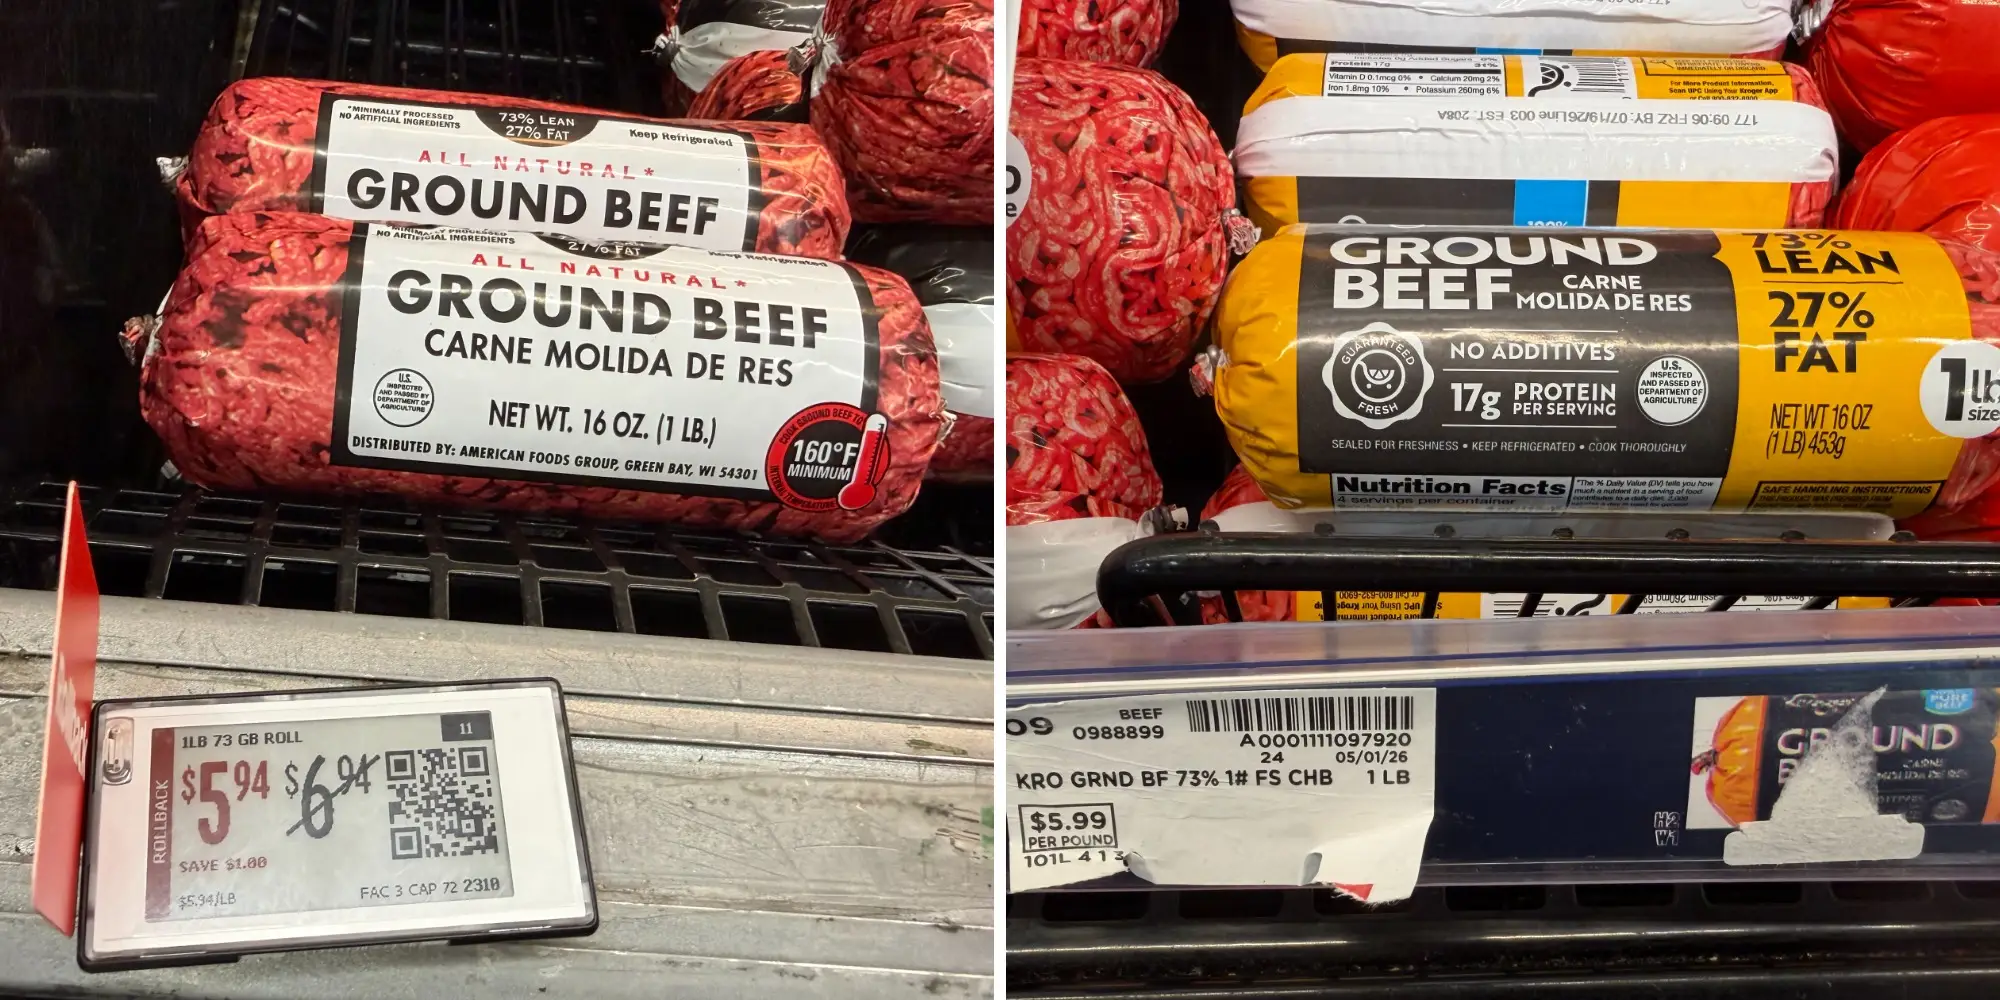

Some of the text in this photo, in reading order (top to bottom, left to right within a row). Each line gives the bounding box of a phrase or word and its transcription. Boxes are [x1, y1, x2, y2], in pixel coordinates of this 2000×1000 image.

[1329, 73, 1358, 81] Vitamin
[1367, 74, 1396, 83] 0.1mcg
[1398, 74, 1411, 82] 0%
[1463, 76, 1485, 84] 20mg
[1328, 84, 1344, 92] Iron
[1345, 85, 1369, 94] 1.8mg
[1372, 85, 1390, 93] 10%
[1416, 86, 1456, 94] Potassium
[1458, 86, 1485, 95] 260mg
[339, 112, 461, 129] NO ARTIFICIAL INGREDIENTS
[403, 110, 454, 121] PROCESSED
[499, 112, 575, 127] 73% LEAN
[1437, 110, 1470, 120] 208A
[1474, 110, 1504, 120] EST.
[1510, 110, 1536, 121] 003
[1629, 112, 1654, 124] BY:
[1658, 113, 1688, 124] FRZ
[1692, 113, 1729, 125] 09:06
[1734, 114, 1758, 126] 177
[505, 125, 570, 141] 27% FAT
[629, 128, 733, 147] Keep Refrigerated
[418, 150, 472, 167] ALL
[347, 168, 719, 236] GROUND BEEF
[1742, 233, 1852, 249] 73%
[1330, 236, 1657, 266] GROUND
[472, 253, 535, 271] ALL
[1755, 250, 1900, 275] LEAN
[1333, 268, 1513, 310] BEEF
[1563, 274, 1642, 290] CARNE
[387, 269, 828, 349] GROUND BEEF
[1516, 292, 1692, 312] MOLIDA DE RES
[1768, 291, 1875, 329] 27%
[425, 328, 793, 387] CARNE MOLIDA DE RES
[1341, 335, 1415, 366] GUARANTEED
[1450, 342, 1616, 361] NO ADDITIVES
[1774, 332, 1867, 373] FAT
[1661, 360, 1682, 371] U.S.
[1639, 388, 1703, 396] DEPARTMENT OF
[1940, 358, 1966, 421] 1
[1357, 401, 1399, 415] FRESH
[1451, 382, 1616, 421] 17g PROTEIN
[1513, 403, 1616, 417] PER SERVING
[1770, 403, 1873, 430] NET WT 16 OZ
[1968, 407, 2000, 421] size
[489, 399, 717, 449] NET WT. 16 OZ. (1 LB.)
[793, 439, 859, 466] 160°F
[1332, 439, 1687, 453] SEALED FOR FRESHNESS KEEP REFRIGERATED COOK THOROUGHLY
[1766, 431, 1846, 459] (1 LB) 453g
[352, 435, 758, 481] DISTRIBUTED BY: AMERICAN FOODS GROUP, GREEN BAY, WI 54301
[787, 463, 852, 481] MINIMUM
[1336, 476, 1567, 495] Nutrition Facts
[1762, 486, 1932, 494] SAFE HANDLING INSTRUCTIONS
[1119, 708, 1163, 720] BEEF
[459, 722, 473, 735] 11
[1073, 725, 1164, 740] 0988899
[182, 731, 303, 749] 1LB 73 GB ROLL
[1261, 751, 1408, 765] 24 05/01/26
[1016, 769, 1410, 790] KRO GRND BF 73% 1# FS CHB 1 LB
[152, 779, 169, 865] ROLLBACK
[1030, 811, 1107, 833] $5.99
[1028, 834, 1114, 849] PER POUND
[179, 856, 267, 873] SAVE $1.00
[1078, 850, 1091, 862] 4
[1098, 850, 1106, 861] 1
[360, 877, 500, 899] FAC 3 CAP 72 2310
